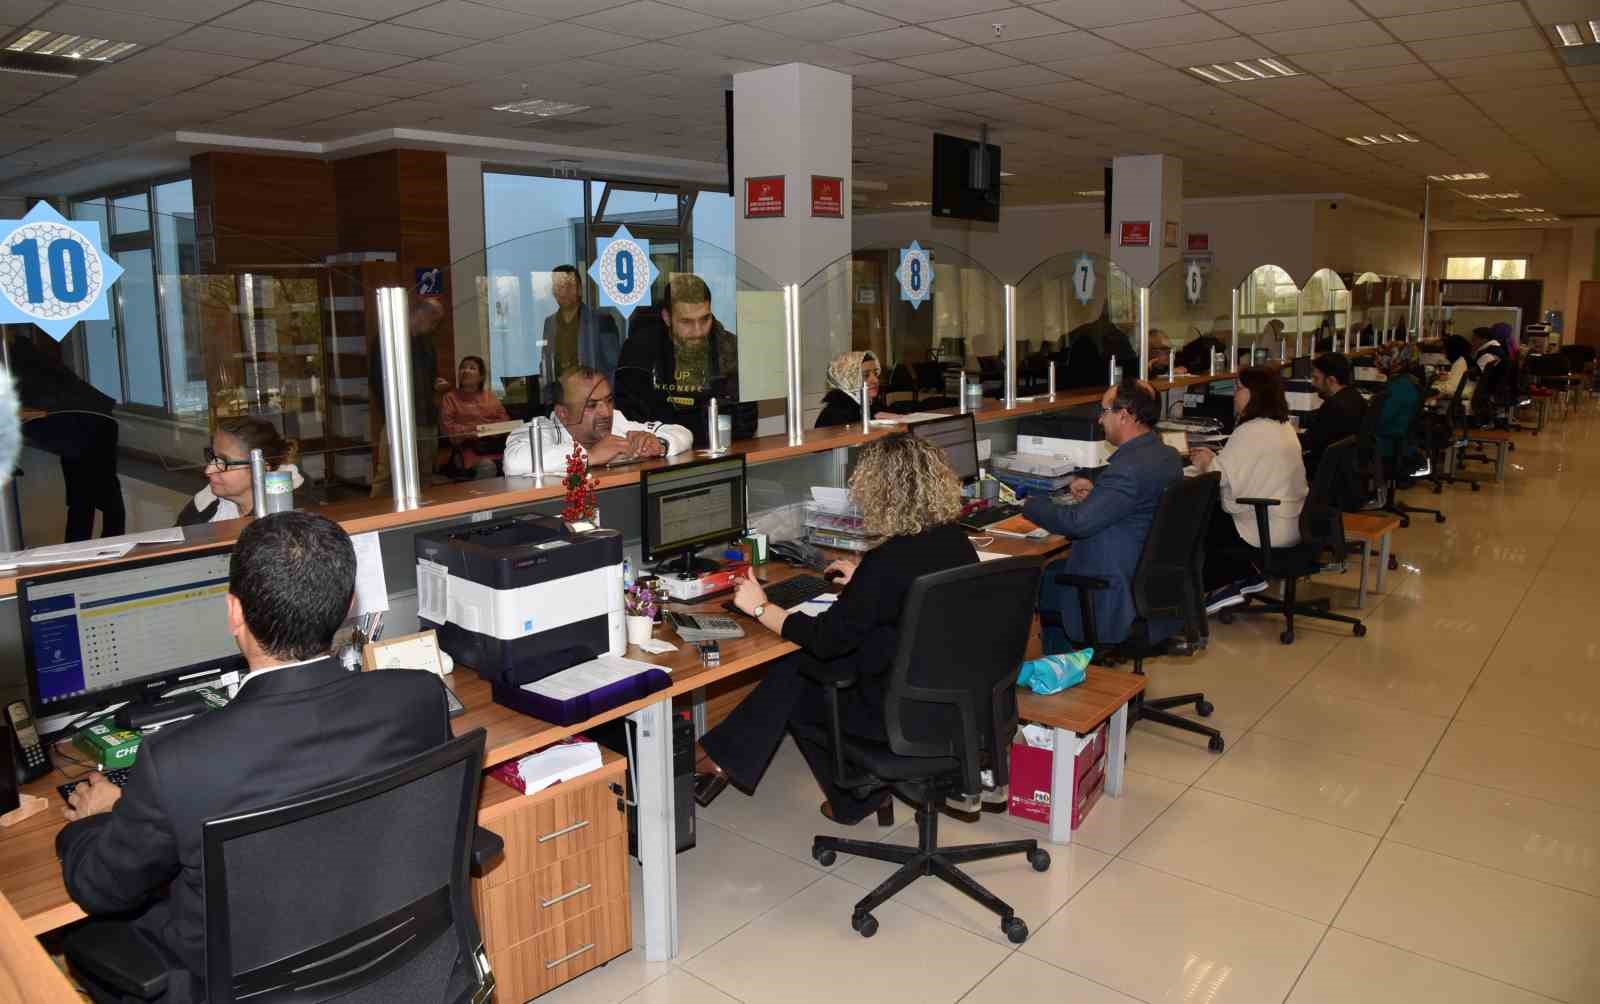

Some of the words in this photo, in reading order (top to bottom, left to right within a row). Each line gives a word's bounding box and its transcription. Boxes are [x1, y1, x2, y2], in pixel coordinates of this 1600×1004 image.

[11, 239, 88, 304] 10
[616, 250, 635, 294] 9
[911, 259, 920, 291] 8
[1081, 266, 1089, 292] 7
[1191, 272, 1197, 294] 6
